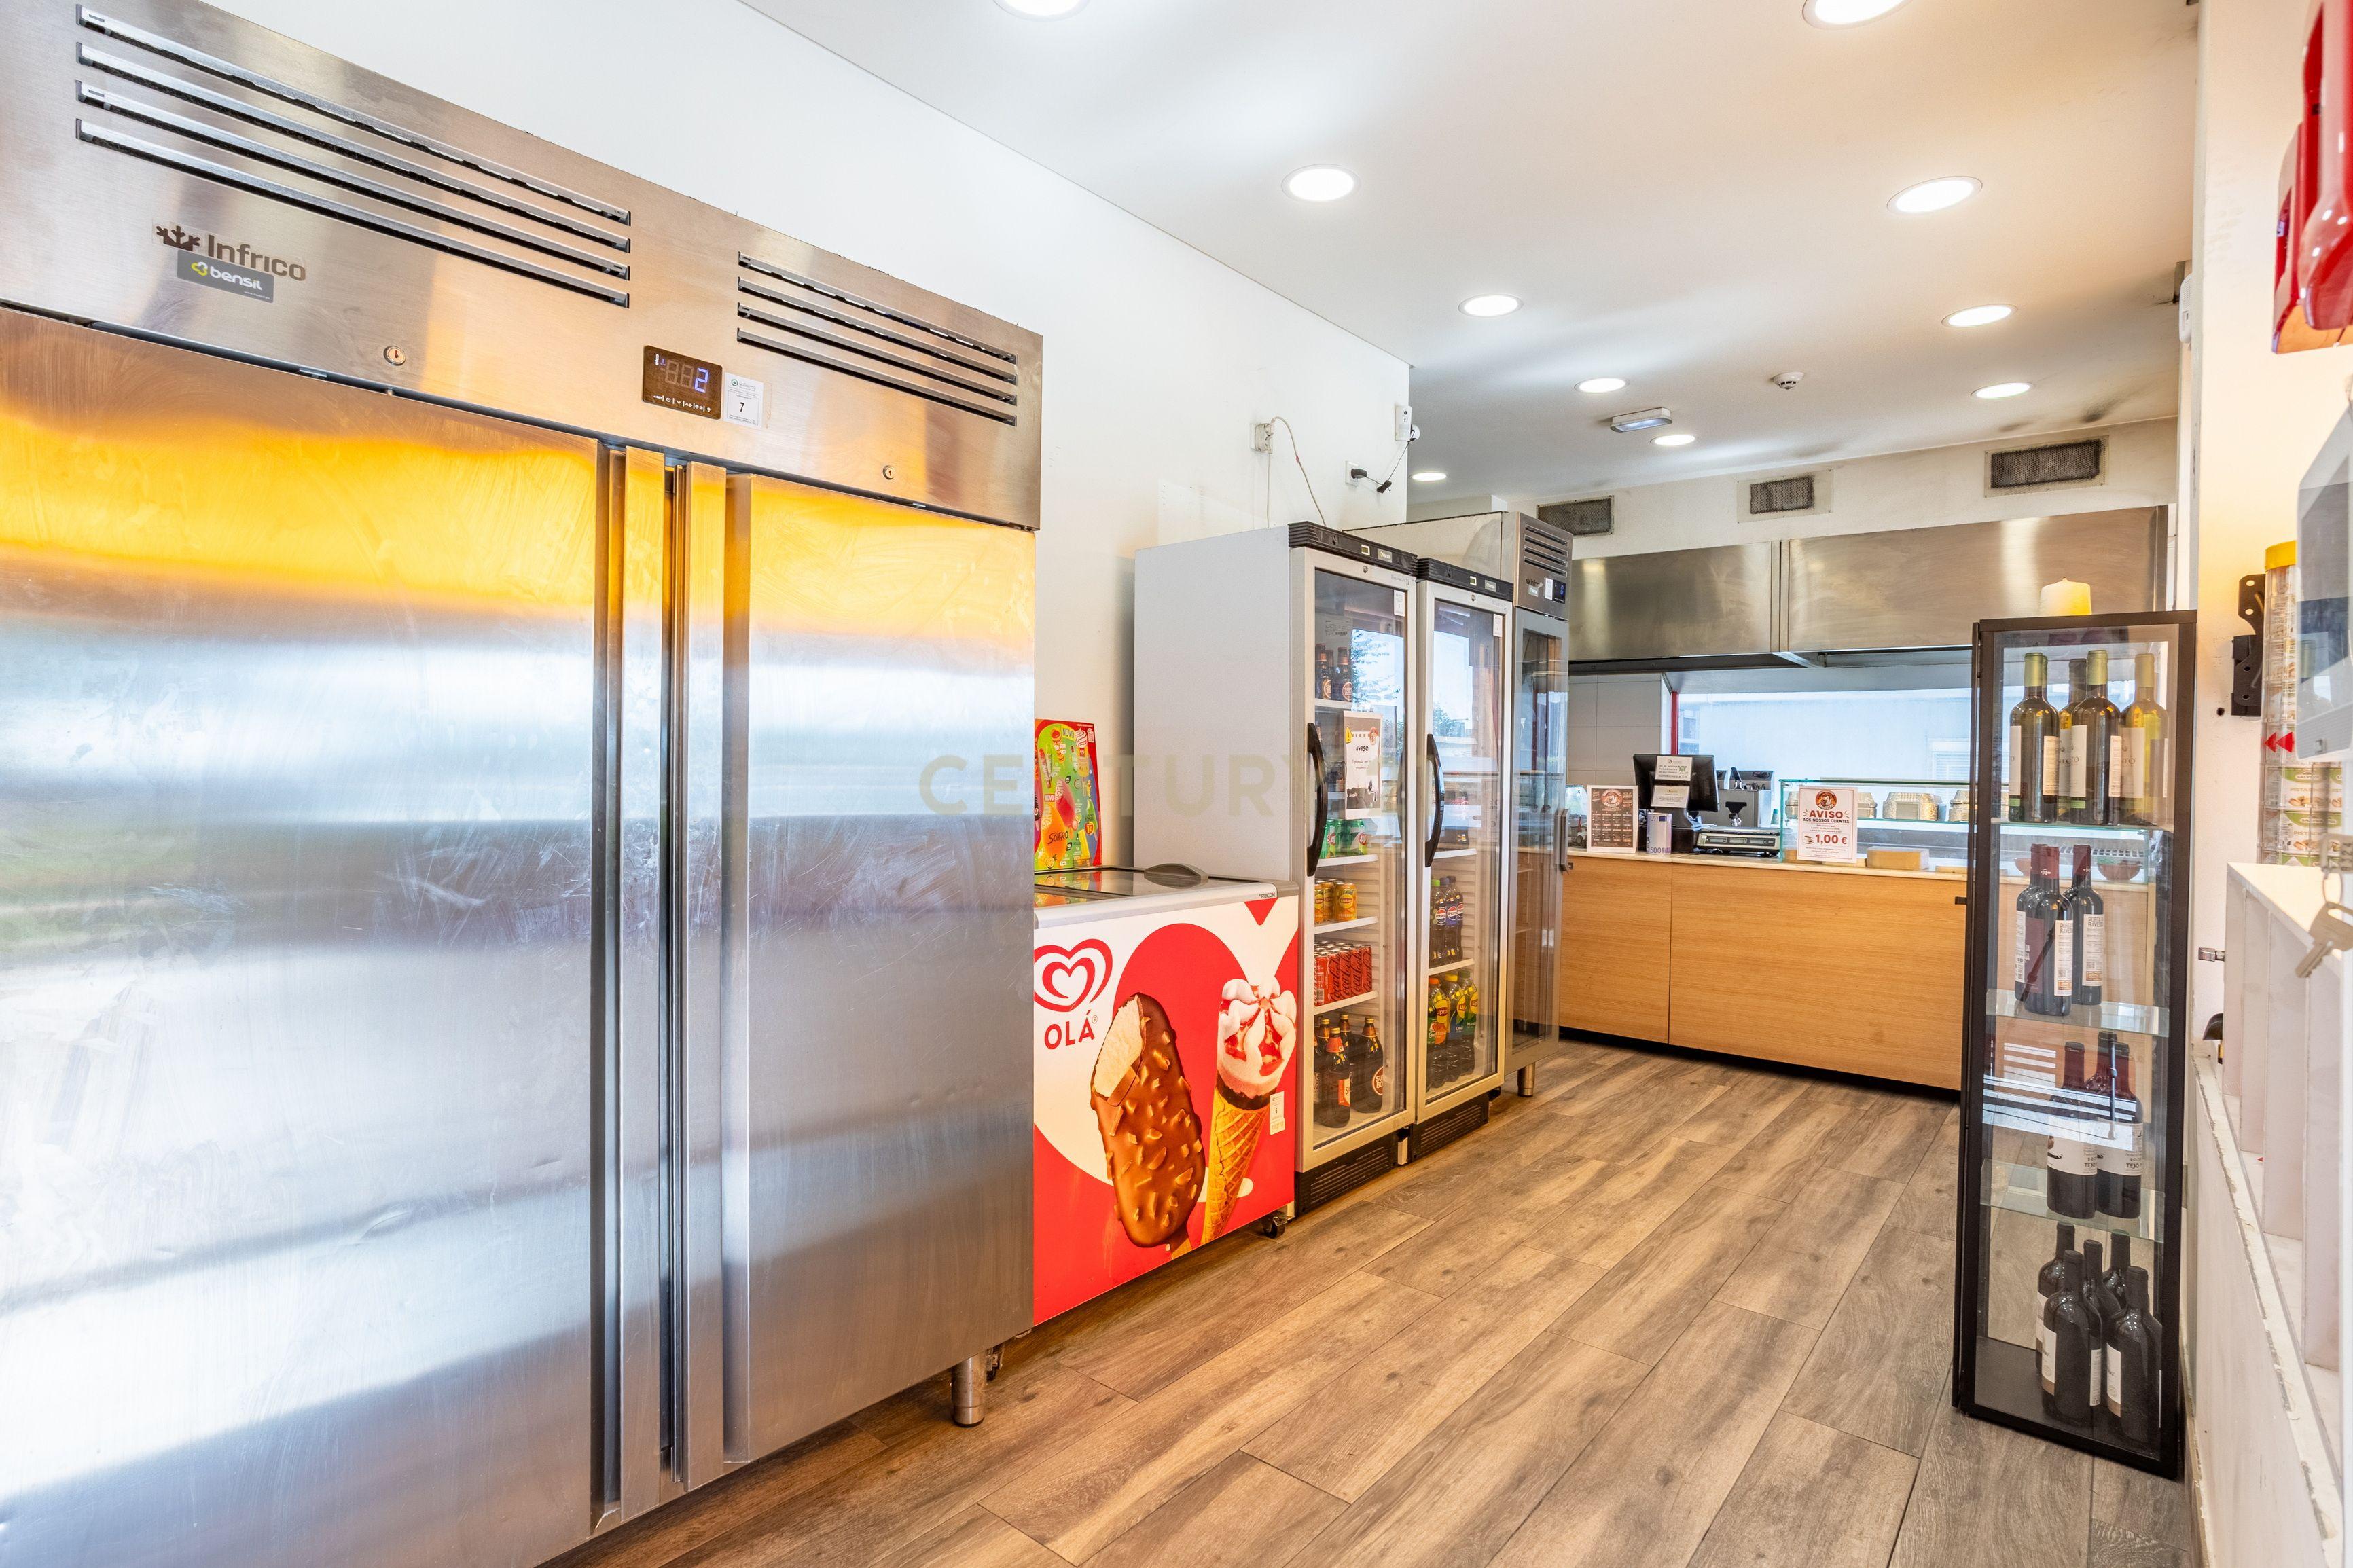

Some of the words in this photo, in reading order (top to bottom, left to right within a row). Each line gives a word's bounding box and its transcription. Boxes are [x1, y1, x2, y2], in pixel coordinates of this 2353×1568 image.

[208, 234, 306, 281] Infrico
[210, 266, 263, 291] bensil
[694, 367, 709, 393] 2
[740, 402, 745, 412] 7
[1062, 729, 1074, 738] NOVO
[1809, 810, 1844, 819] AVISO
[1047, 831, 1068, 845] SOLERO
[1815, 834, 1839, 844] 1,00
[1841, 837, 1848, 845] €
[1045, 1010, 1095, 1049] OLÁ
